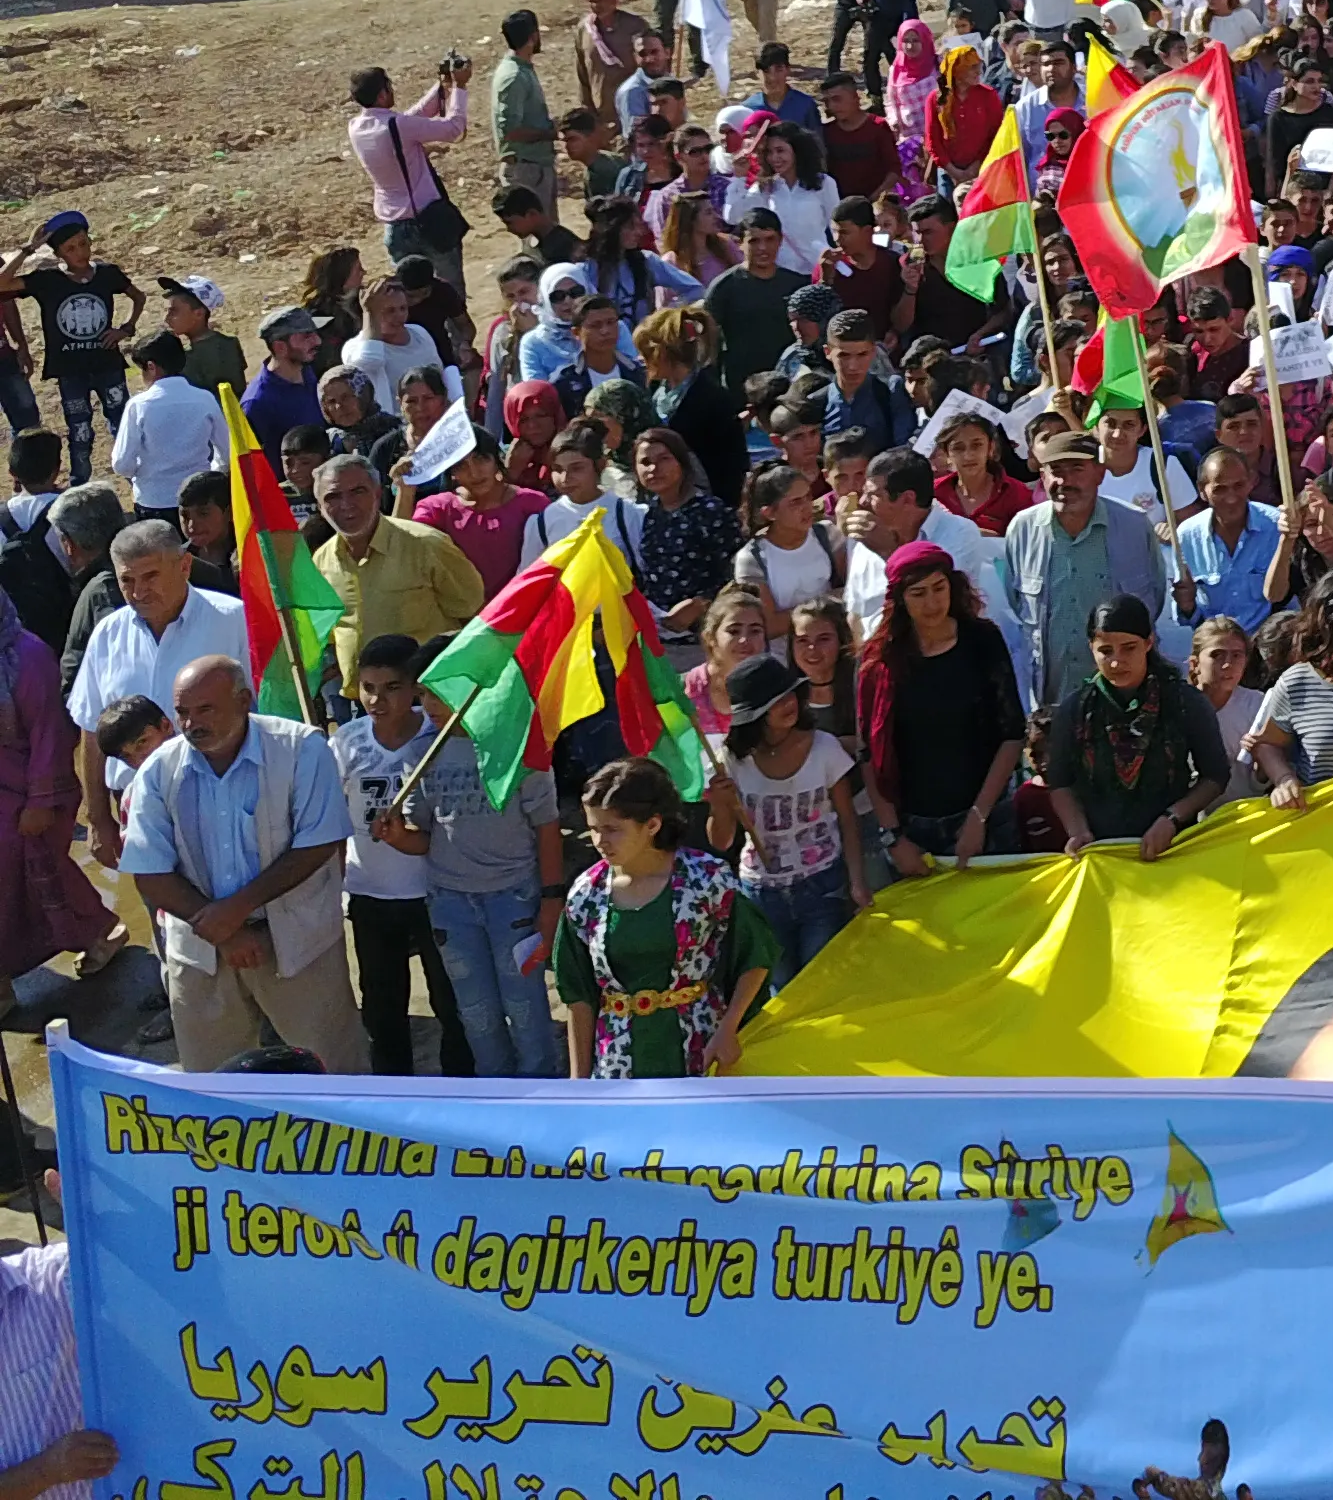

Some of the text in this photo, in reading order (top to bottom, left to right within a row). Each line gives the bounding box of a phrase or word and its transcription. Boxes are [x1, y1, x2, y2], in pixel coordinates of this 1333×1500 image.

[61, 341, 103, 352] ATHEI
[101, 1092, 437, 1177] Rizgarkirina
[173, 1186, 209, 1272] ji
[431, 1215, 758, 1318] dagirkeriya
[772, 1224, 963, 1327] turkiyê
[973, 1250, 1054, 1329] ye.
[179, 1321, 388, 1428] سوريا
[403, 1344, 613, 1444] تحرير
